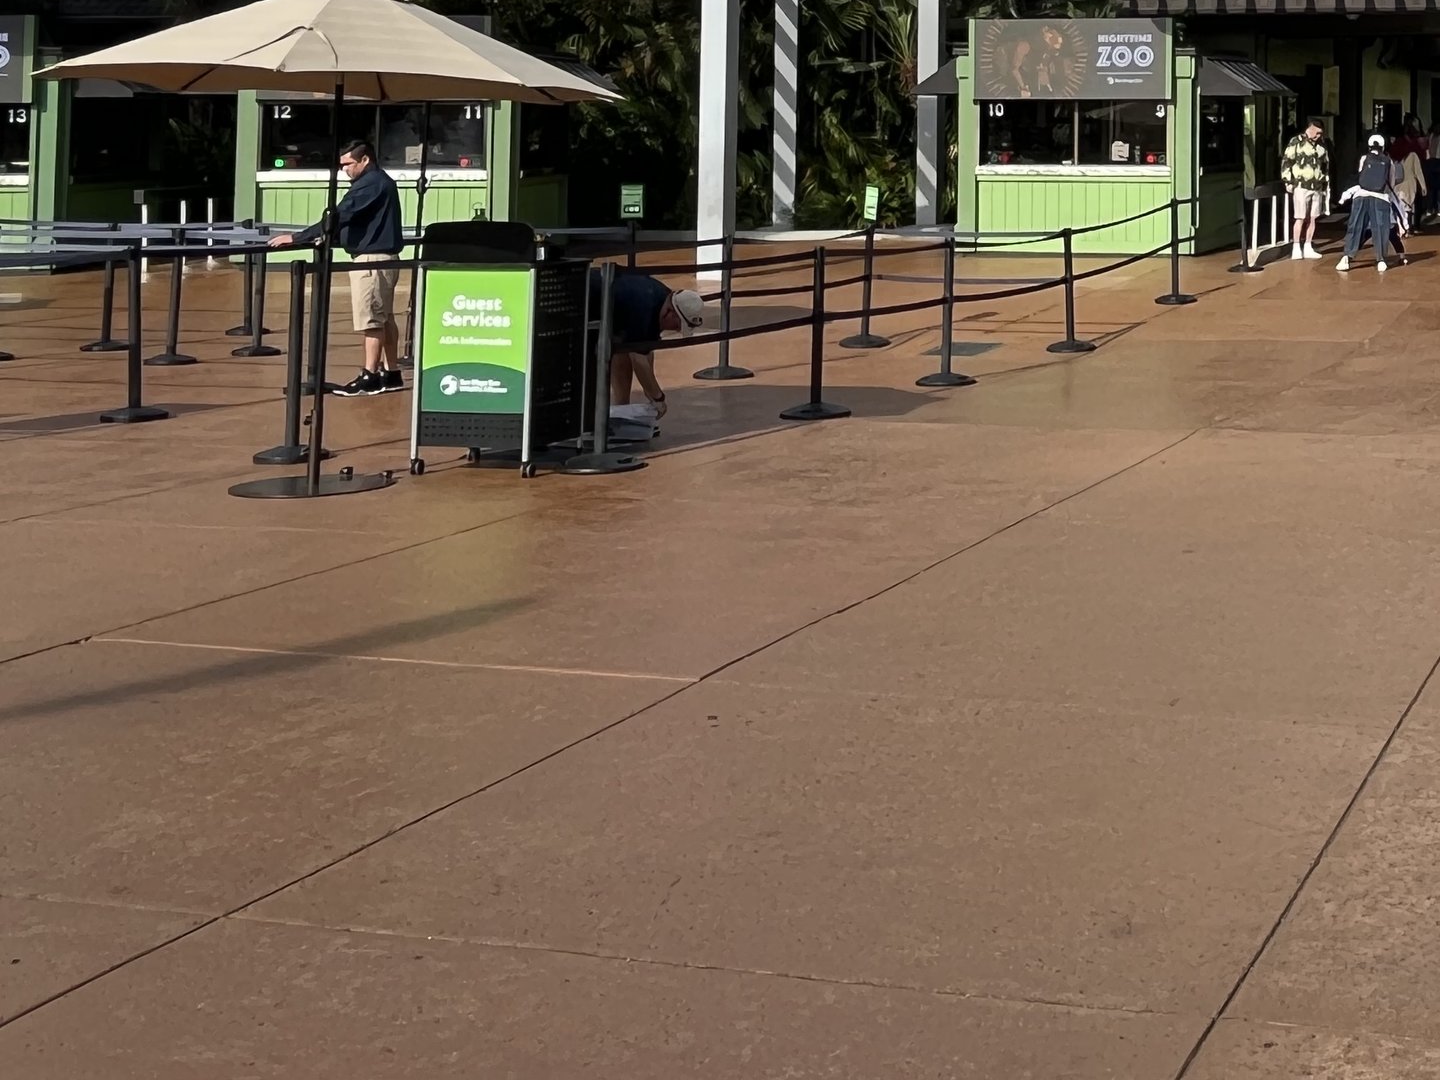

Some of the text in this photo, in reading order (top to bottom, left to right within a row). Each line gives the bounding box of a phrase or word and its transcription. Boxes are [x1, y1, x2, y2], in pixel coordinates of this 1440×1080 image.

[1097, 34, 1152, 43] NIGHTTIME
[1096, 45, 1154, 67] ZOO
[8, 109, 27, 123] 13
[273, 105, 292, 119] 12
[463, 105, 482, 120] 11
[989, 103, 1005, 117] 10
[1155, 104, 1165, 118] 9
[452, 294, 503, 311] Guest
[442, 311, 511, 328] Services
